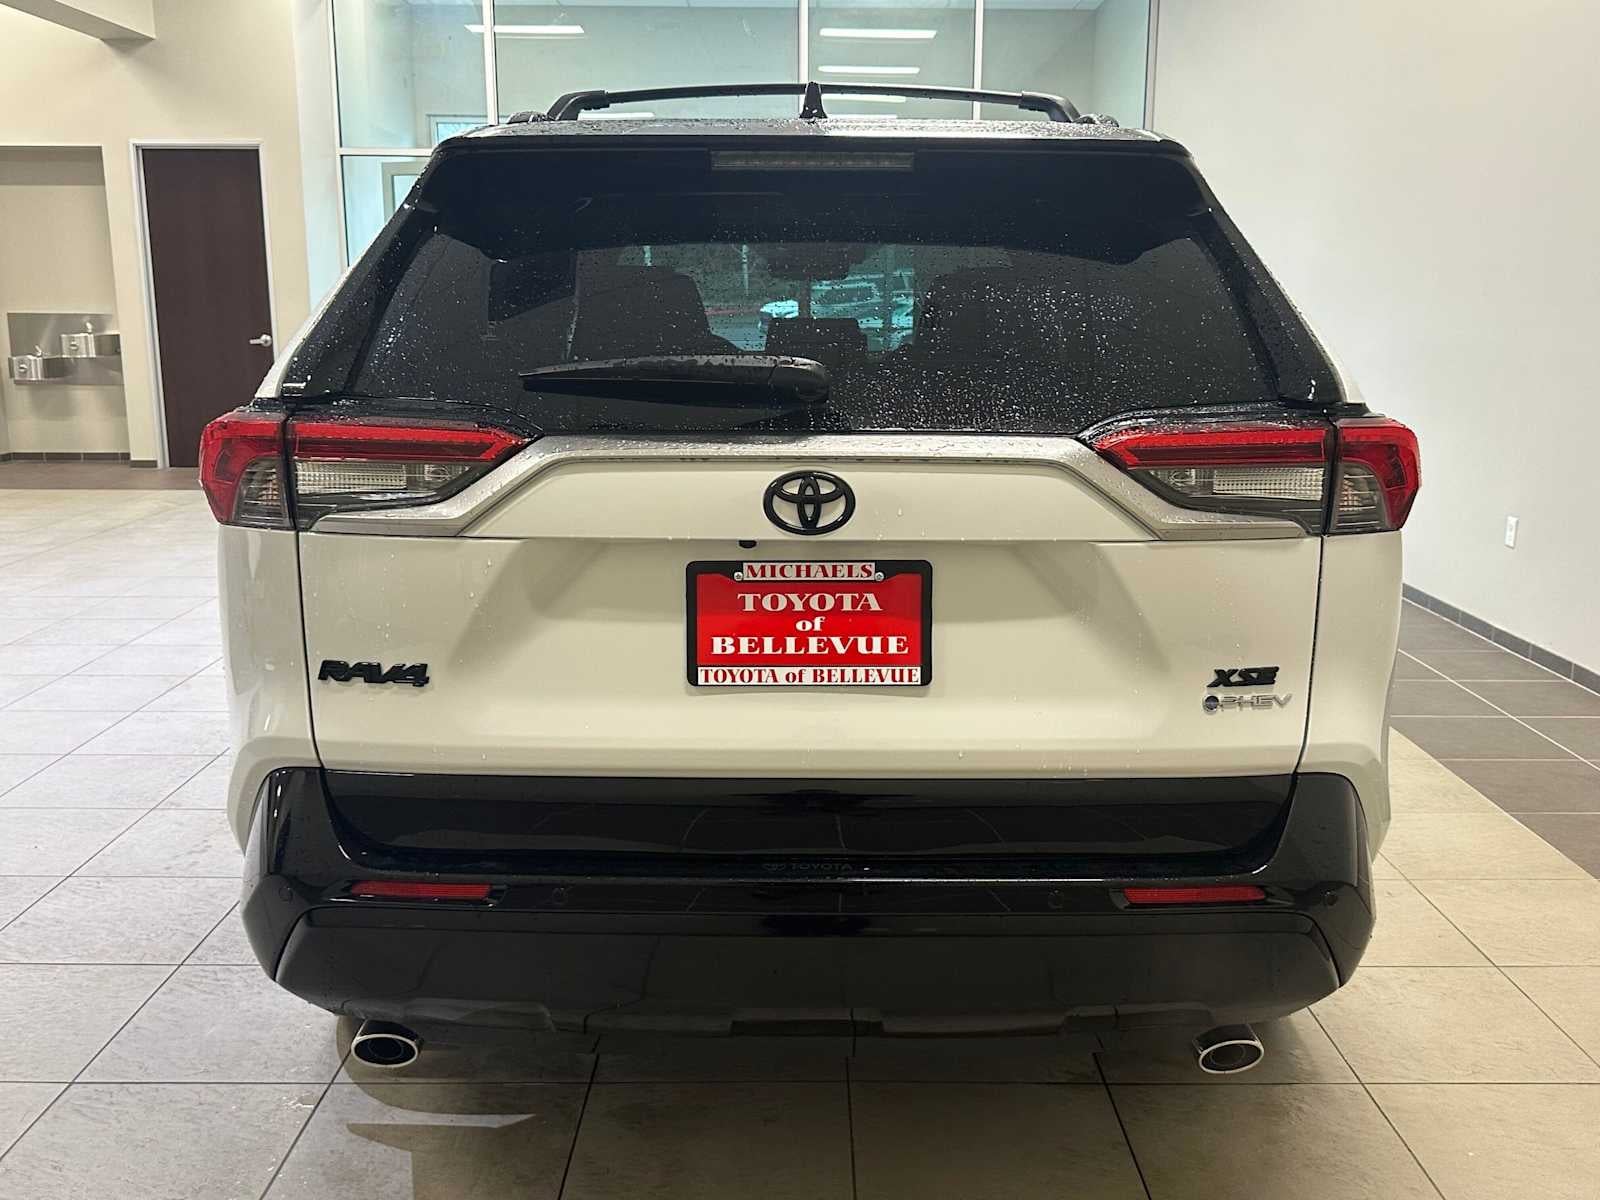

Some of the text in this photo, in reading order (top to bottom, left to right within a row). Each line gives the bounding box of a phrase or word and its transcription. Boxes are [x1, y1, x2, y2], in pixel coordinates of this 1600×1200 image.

[746, 563, 873, 578] MICHAELS
[737, 593, 883, 611] TOYOTA
[795, 616, 826, 632] of
[711, 636, 909, 655] BELLEVUE
[318, 660, 430, 687] RAV4
[700, 668, 919, 683] TOYOTA of BELLEVUE
[1206, 666, 1280, 688] XSE
[1220, 694, 1293, 711] PHEV
[791, 863, 853, 871] TOYOTA
